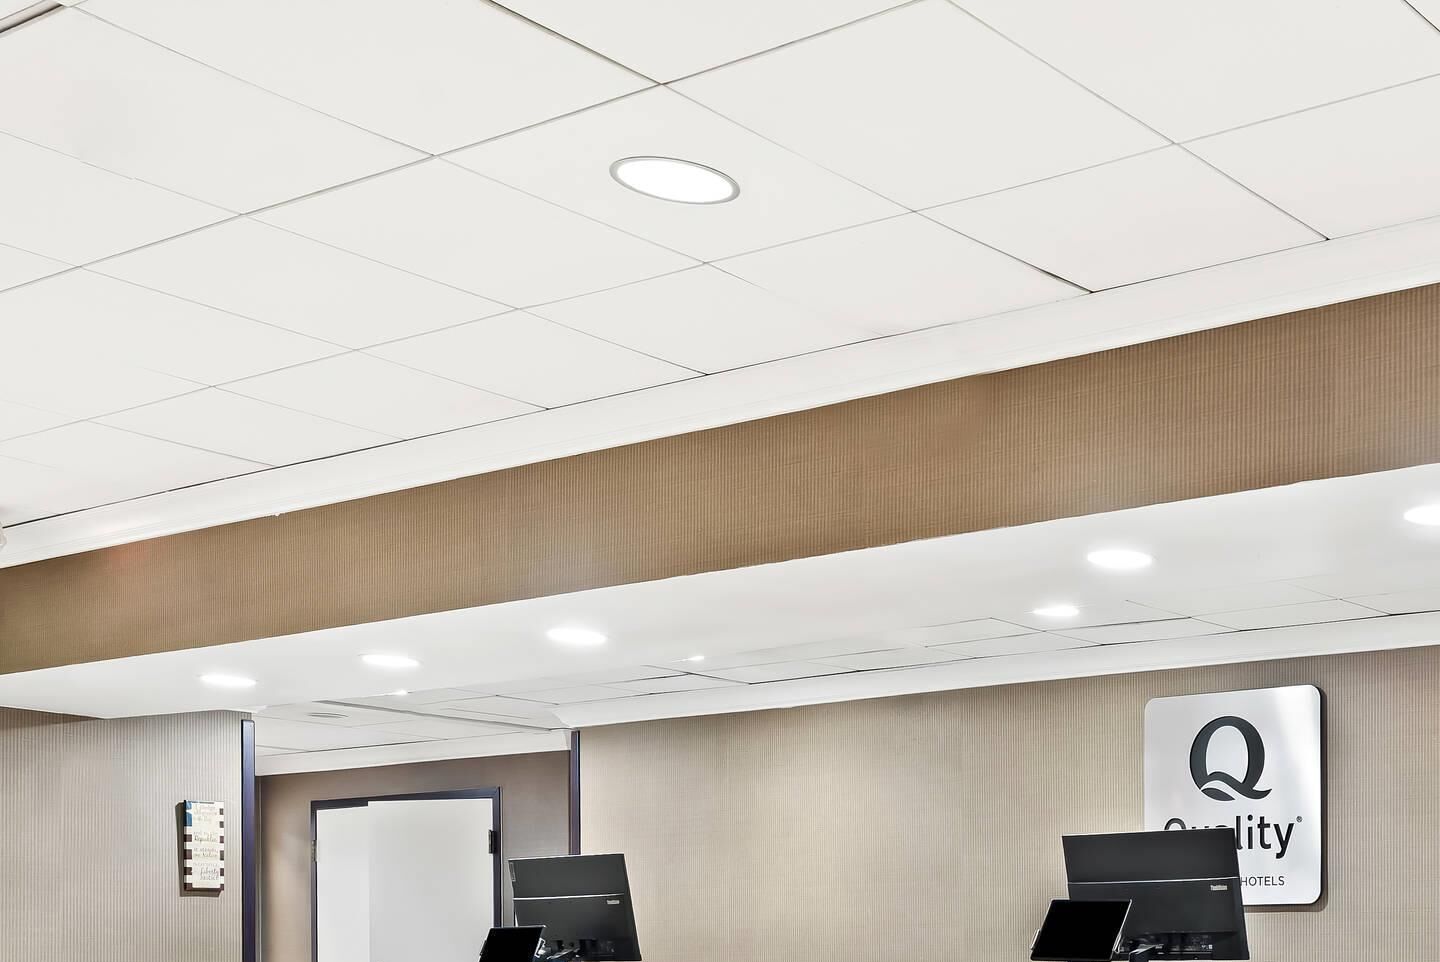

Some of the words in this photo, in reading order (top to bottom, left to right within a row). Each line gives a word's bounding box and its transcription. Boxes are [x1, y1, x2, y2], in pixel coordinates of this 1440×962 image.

[1189, 715, 1272, 801] Q
[1164, 814, 1295, 859] lity
[1240, 875, 1285, 886] HOTELS
